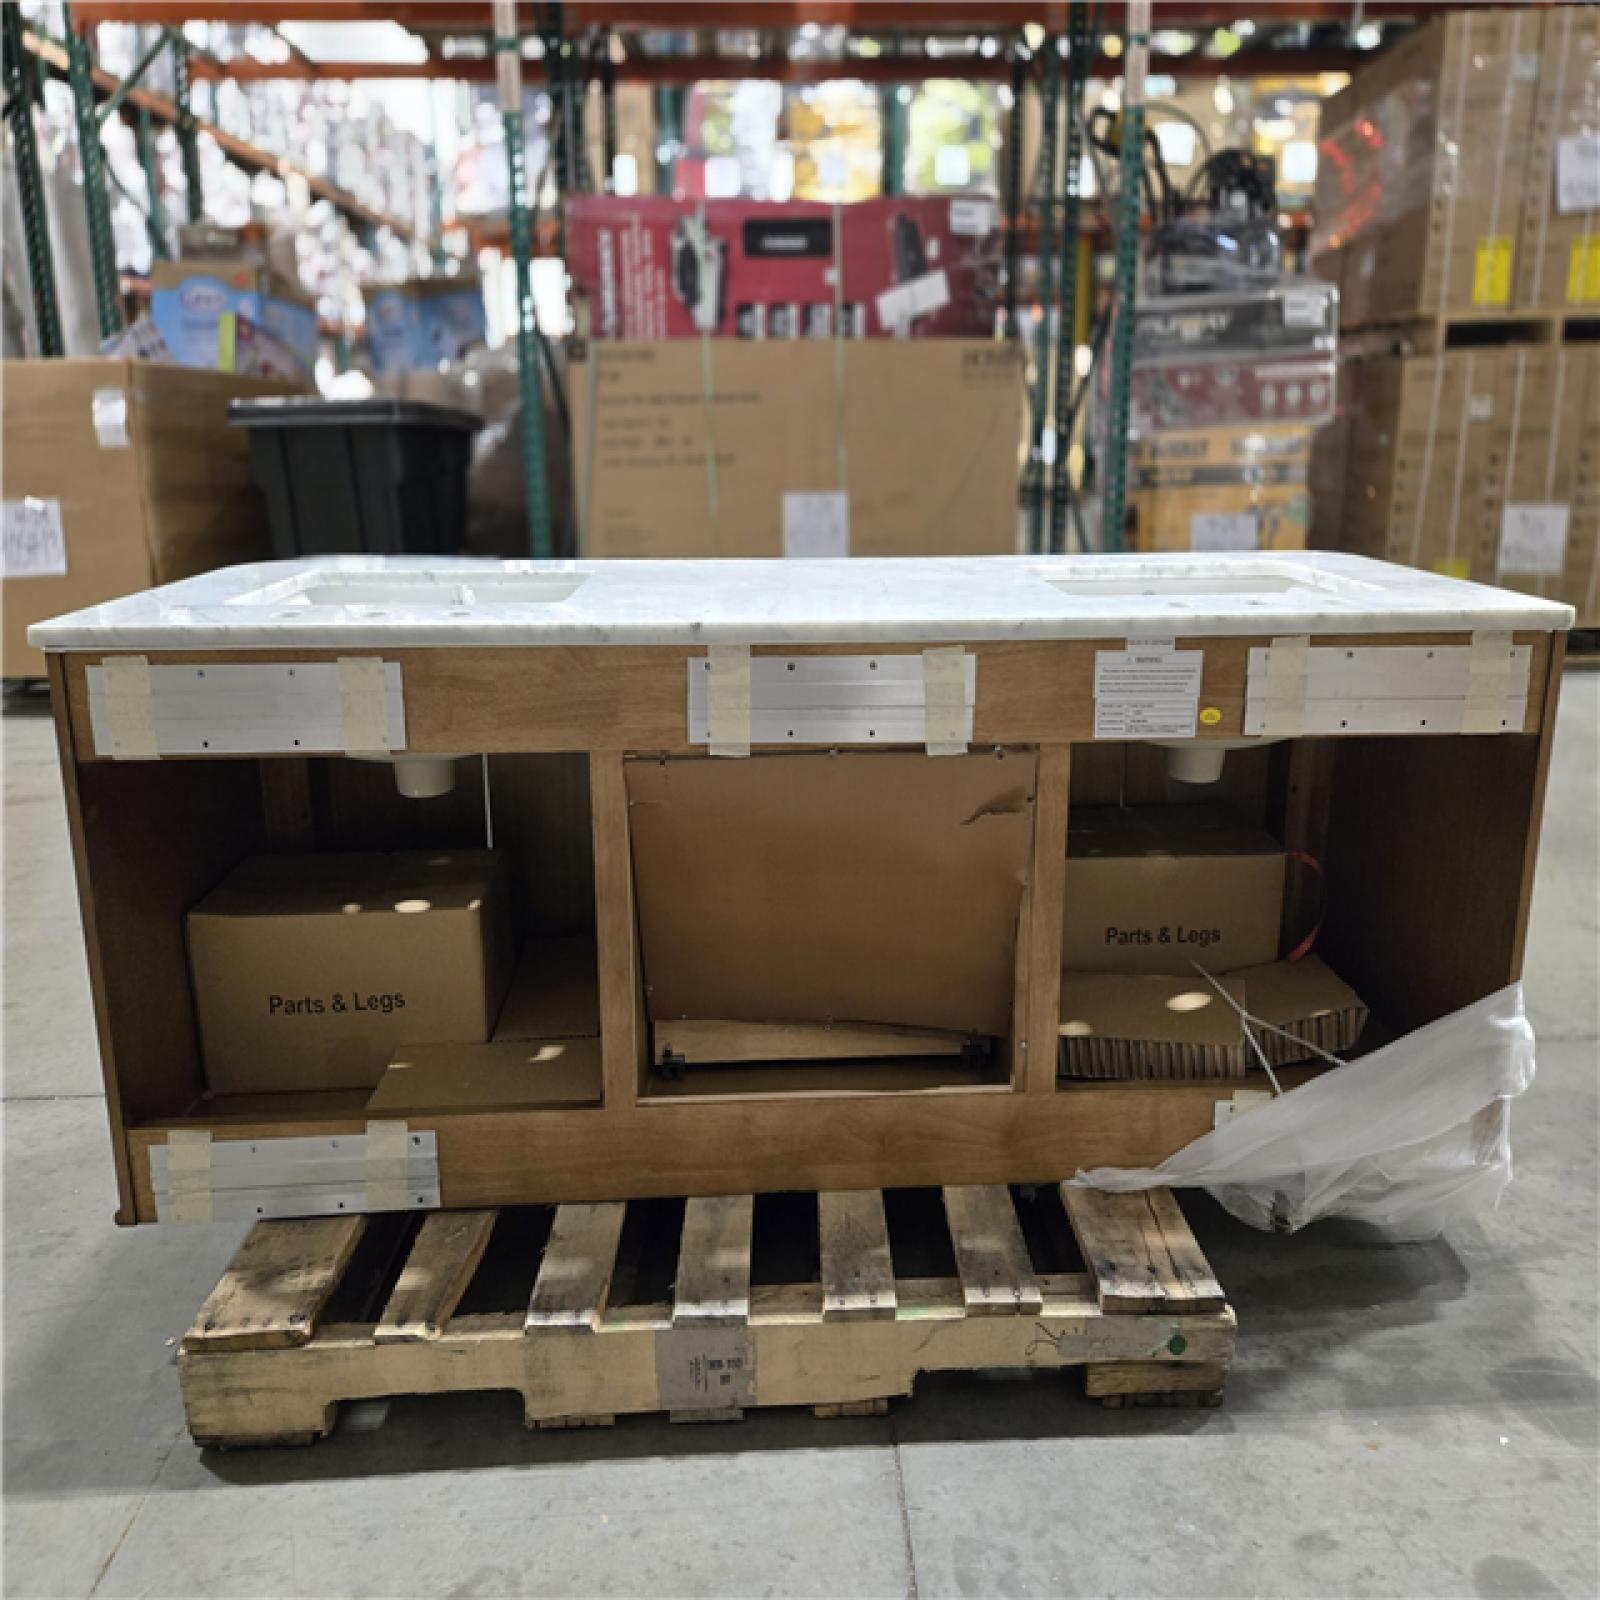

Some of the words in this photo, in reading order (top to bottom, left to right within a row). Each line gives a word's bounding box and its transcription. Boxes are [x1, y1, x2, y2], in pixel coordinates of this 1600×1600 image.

[1105, 926, 1153, 945] Parts
[1157, 926, 1171, 944] &
[1176, 925, 1221, 948] Legs
[268, 994, 326, 1015] Parts
[331, 992, 348, 1013] &
[353, 991, 406, 1015] Legs
